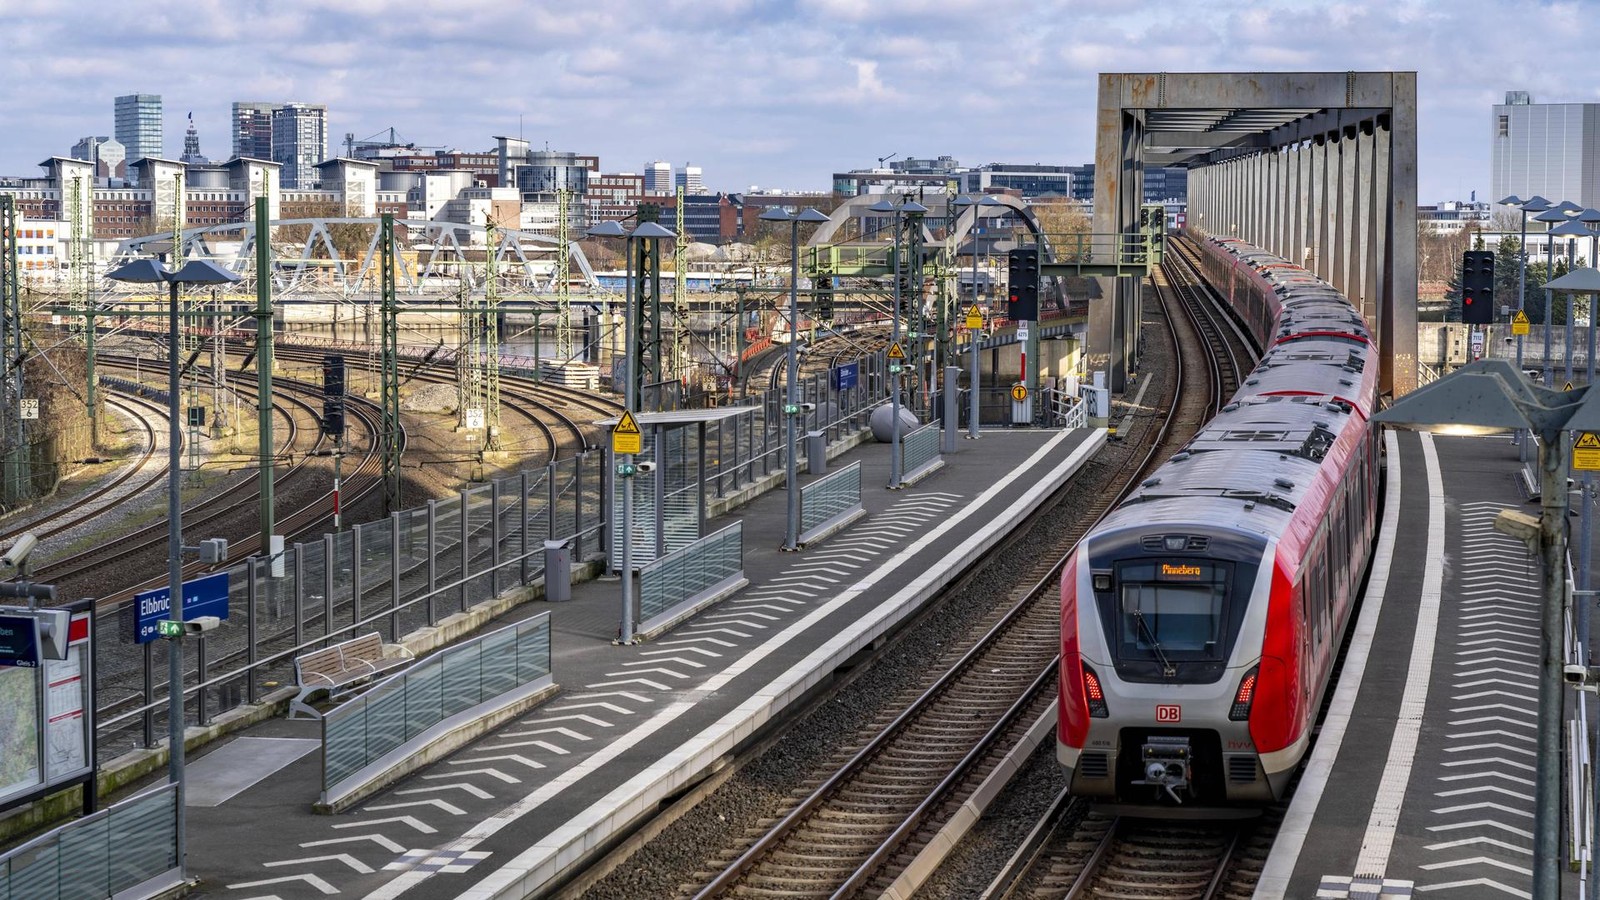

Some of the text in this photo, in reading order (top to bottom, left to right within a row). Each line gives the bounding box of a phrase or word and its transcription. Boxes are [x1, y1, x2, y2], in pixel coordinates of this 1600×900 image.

[703, 375, 715, 383] 352
[21, 400, 38, 409] 352
[26, 409, 32, 417] 6
[468, 410, 482, 418] 352
[141, 595, 170, 616] Elbbrüc
[1159, 707, 1179, 720] DB
